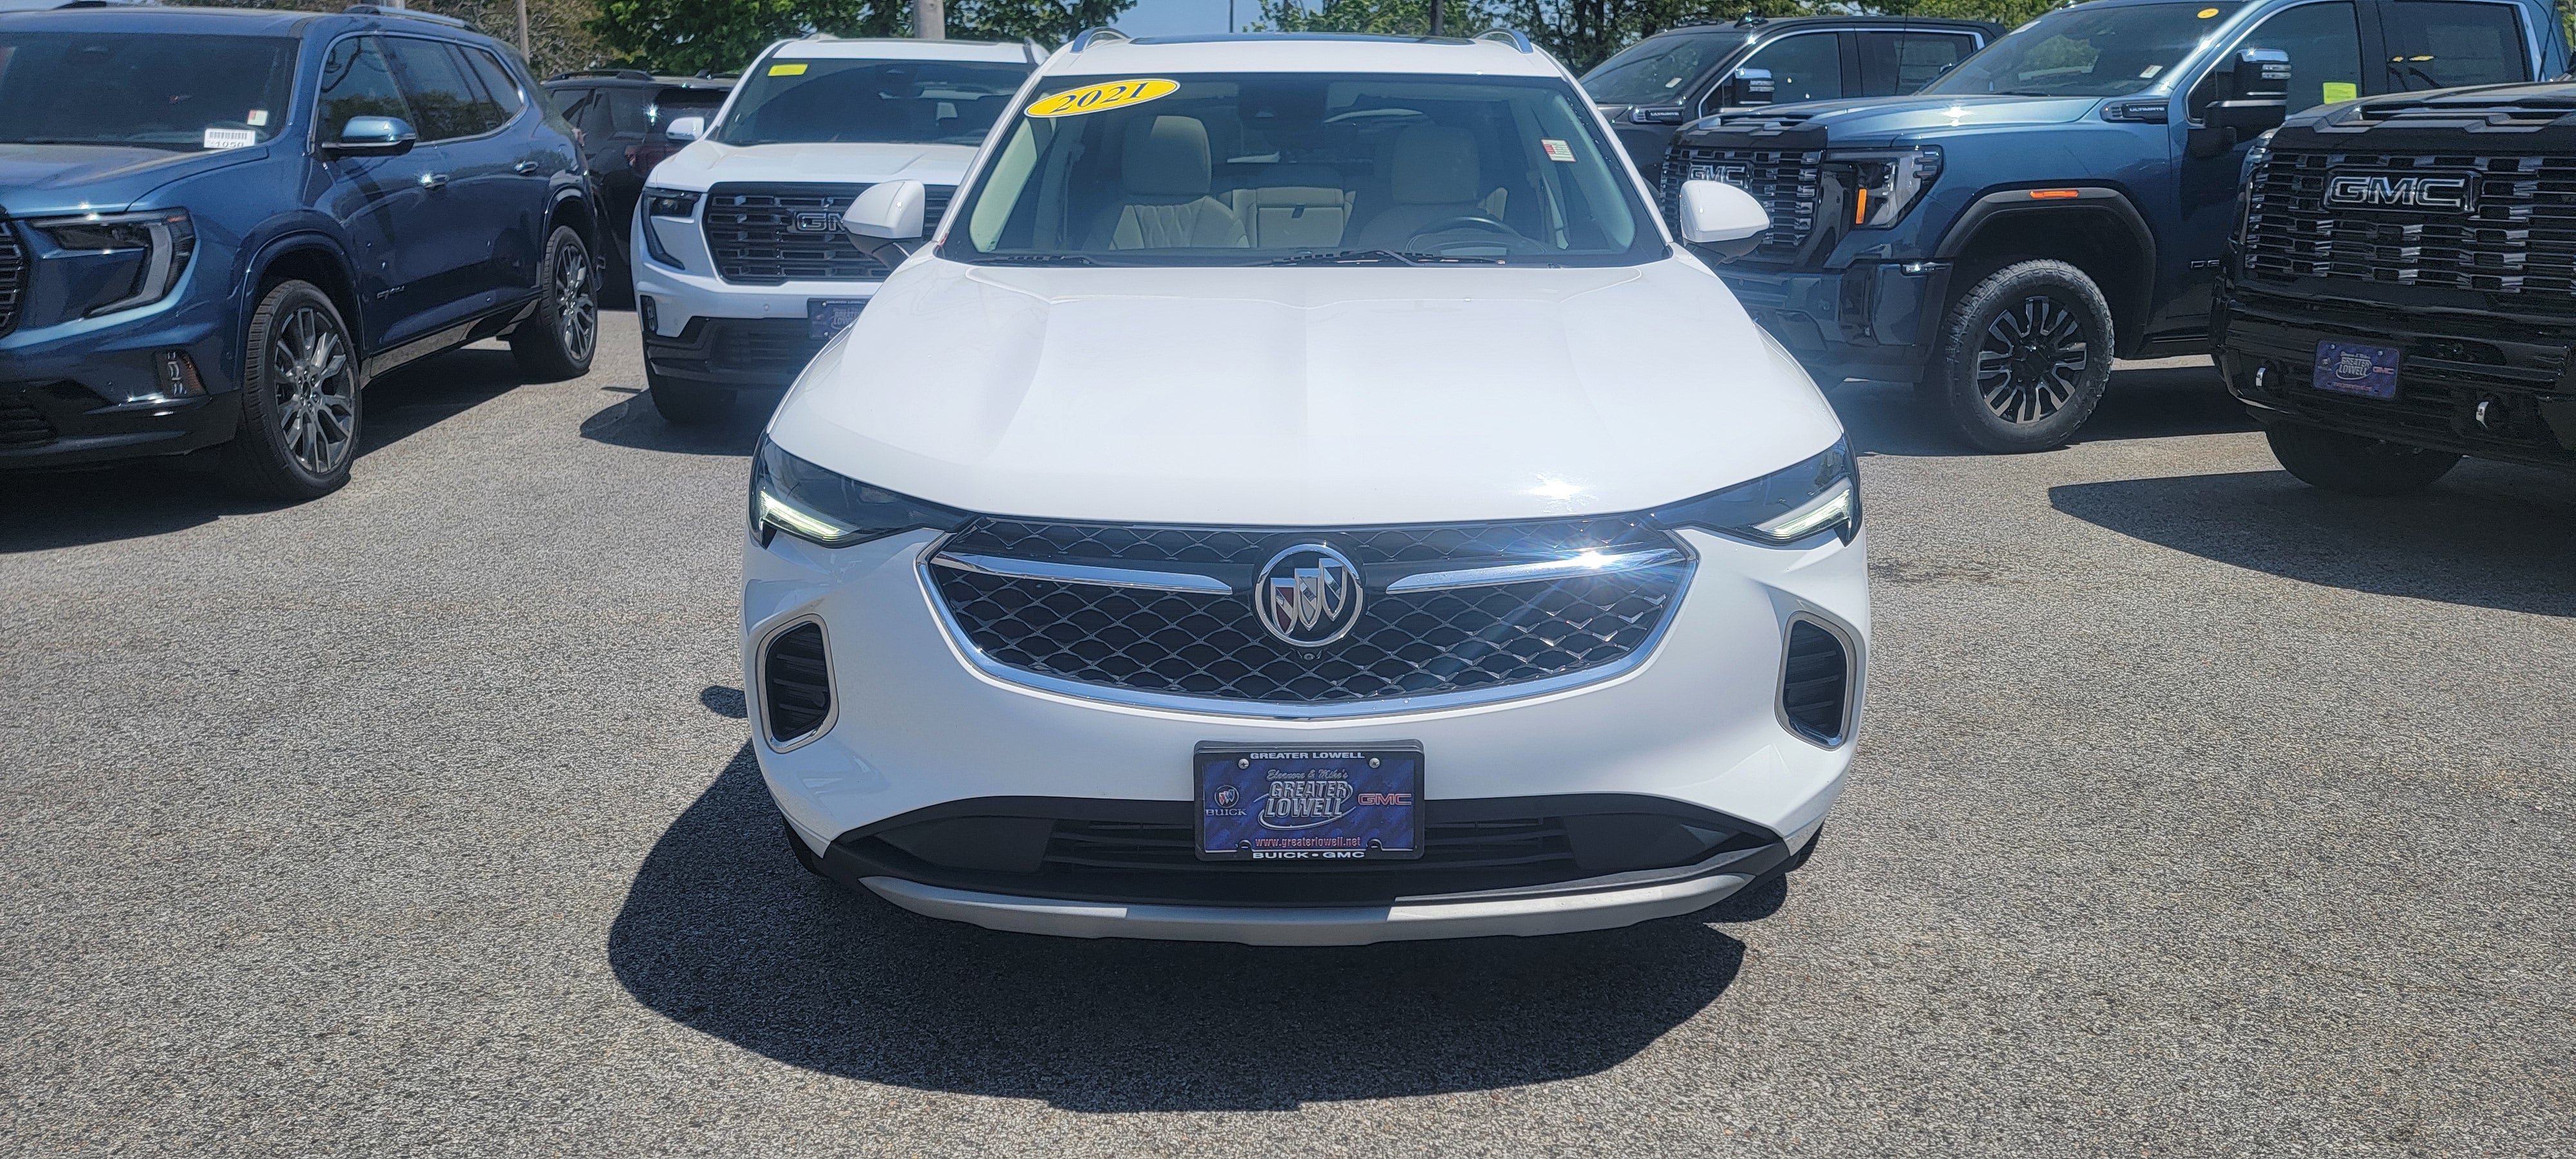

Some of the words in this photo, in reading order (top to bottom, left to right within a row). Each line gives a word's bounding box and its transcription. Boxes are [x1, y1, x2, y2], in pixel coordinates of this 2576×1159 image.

[1049, 82, 1149, 114] 2021
[1687, 164, 1745, 187] GMC
[2330, 176, 2465, 208] GMC
[2338, 364, 2368, 377] LOWELL
[1307, 769, 1316, 780] &
[1318, 768, 1349, 780] Mike's
[1269, 780, 1349, 798] GREATER
[1264, 798, 1343, 817] LOWELL
[1358, 793, 1412, 806] GMC
[1255, 836, 1361, 848] www.greaterlowell.net
